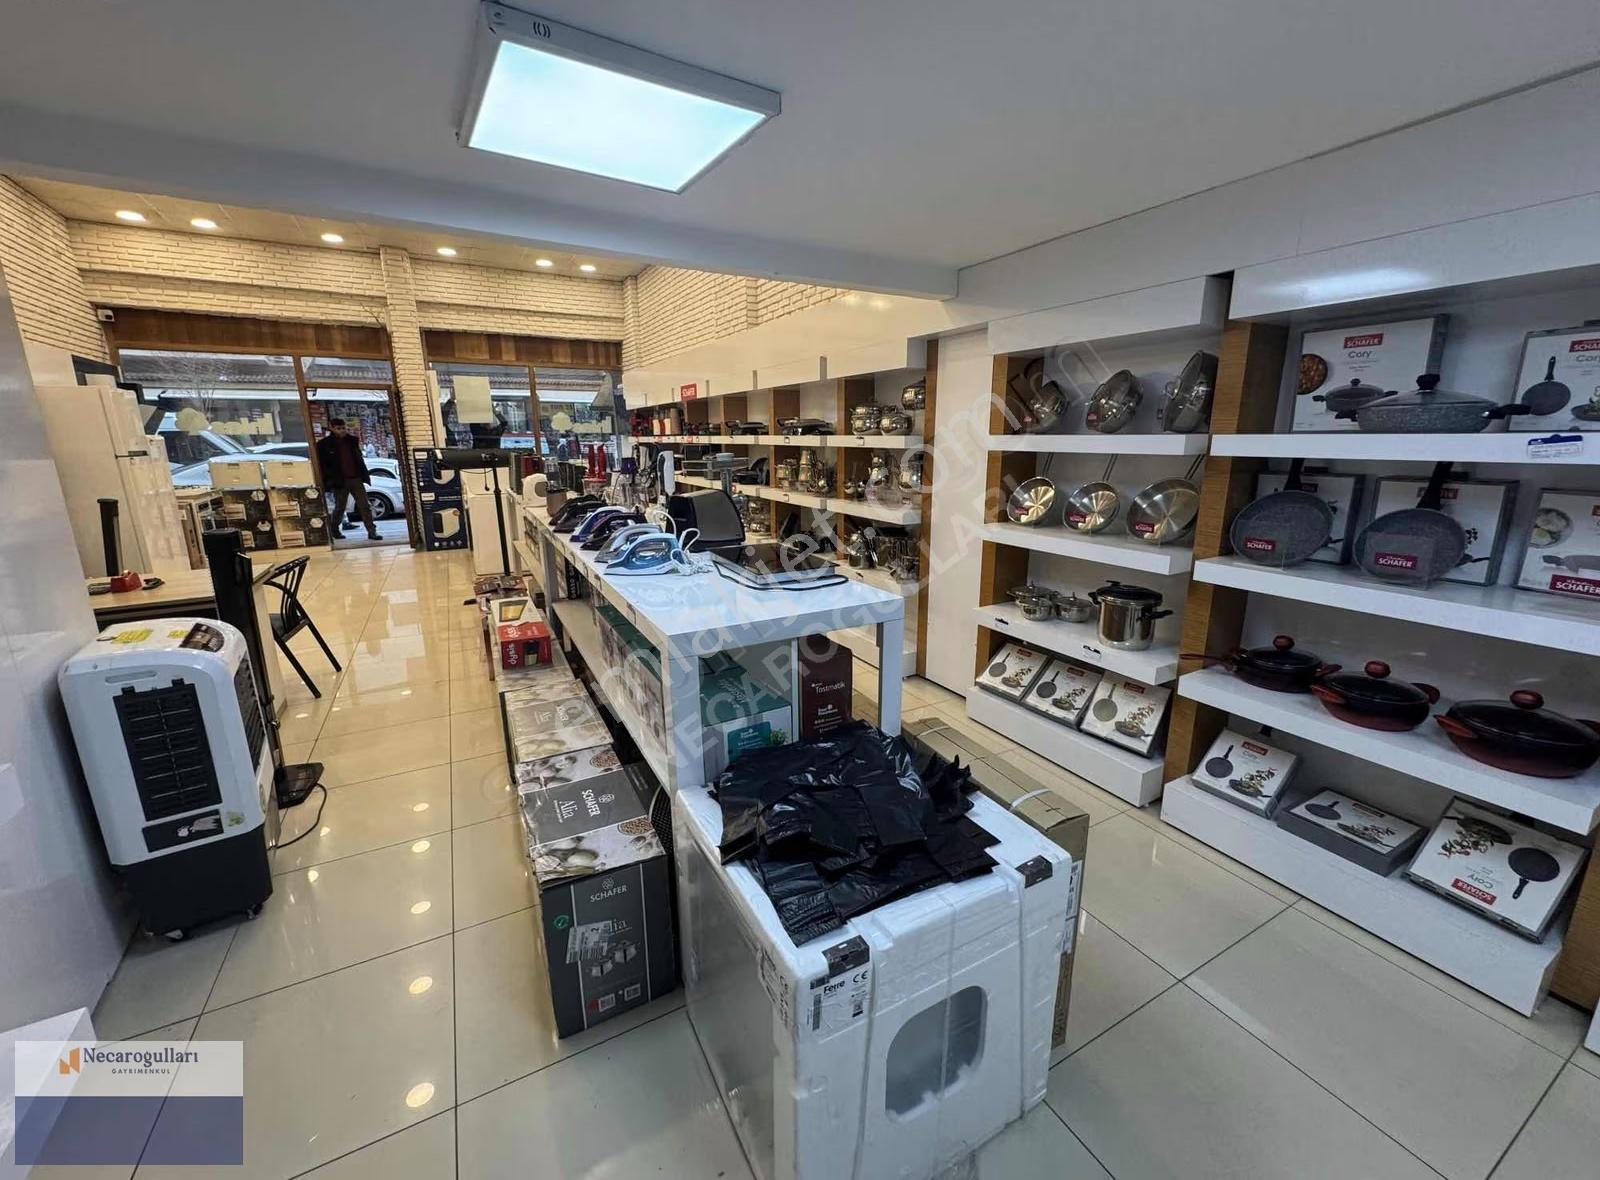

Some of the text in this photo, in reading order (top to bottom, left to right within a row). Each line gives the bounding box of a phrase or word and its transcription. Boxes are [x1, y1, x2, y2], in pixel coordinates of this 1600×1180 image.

[1378, 557, 1413, 569] SCHAFER
[815, 681, 846, 695] Tostmatik
[581, 788, 601, 818] SCHAFER
[589, 884, 628, 903] SCHAFER
[1456, 880, 1493, 903] SCHAFER
[823, 979, 846, 994] Ferre
